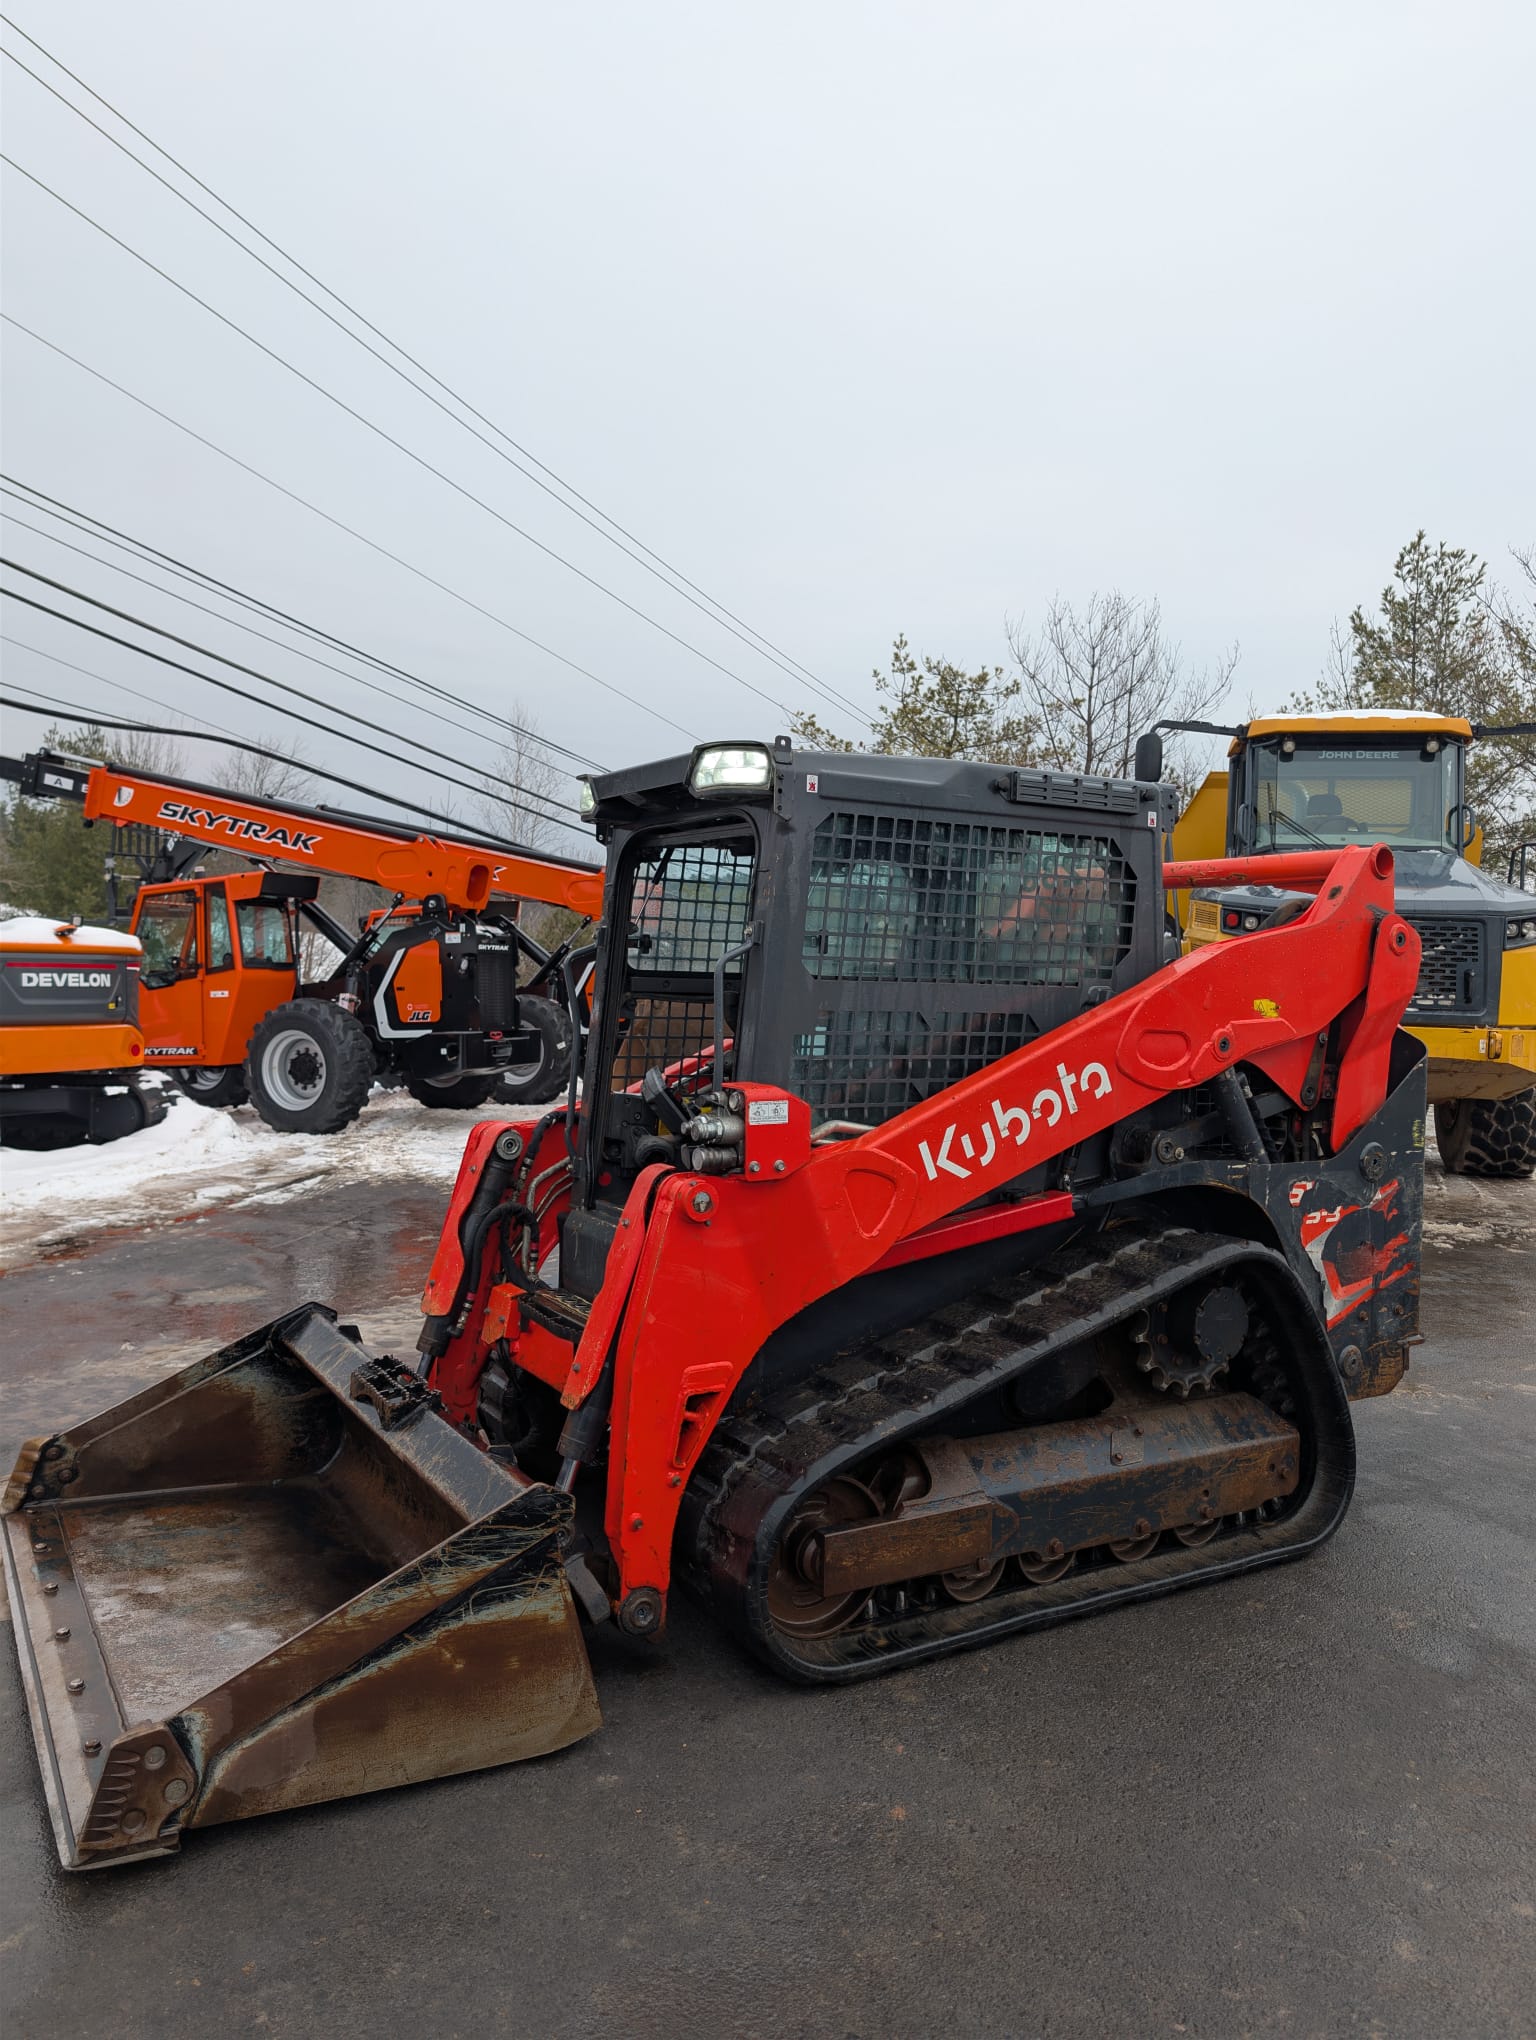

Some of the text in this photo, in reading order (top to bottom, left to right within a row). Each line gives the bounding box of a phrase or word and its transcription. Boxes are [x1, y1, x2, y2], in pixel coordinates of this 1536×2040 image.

[1318, 750, 1399, 759] JOHN DEERE
[54, 778, 63, 786] A
[157, 801, 323, 854] SKYTRAK
[478, 943, 509, 951] SKYTRAK
[21, 972, 111, 987] DEVELON
[408, 1010, 432, 1022] JLG
[144, 1047, 195, 1055] KYTRAK
[918, 1062, 1112, 1181] Kubota
